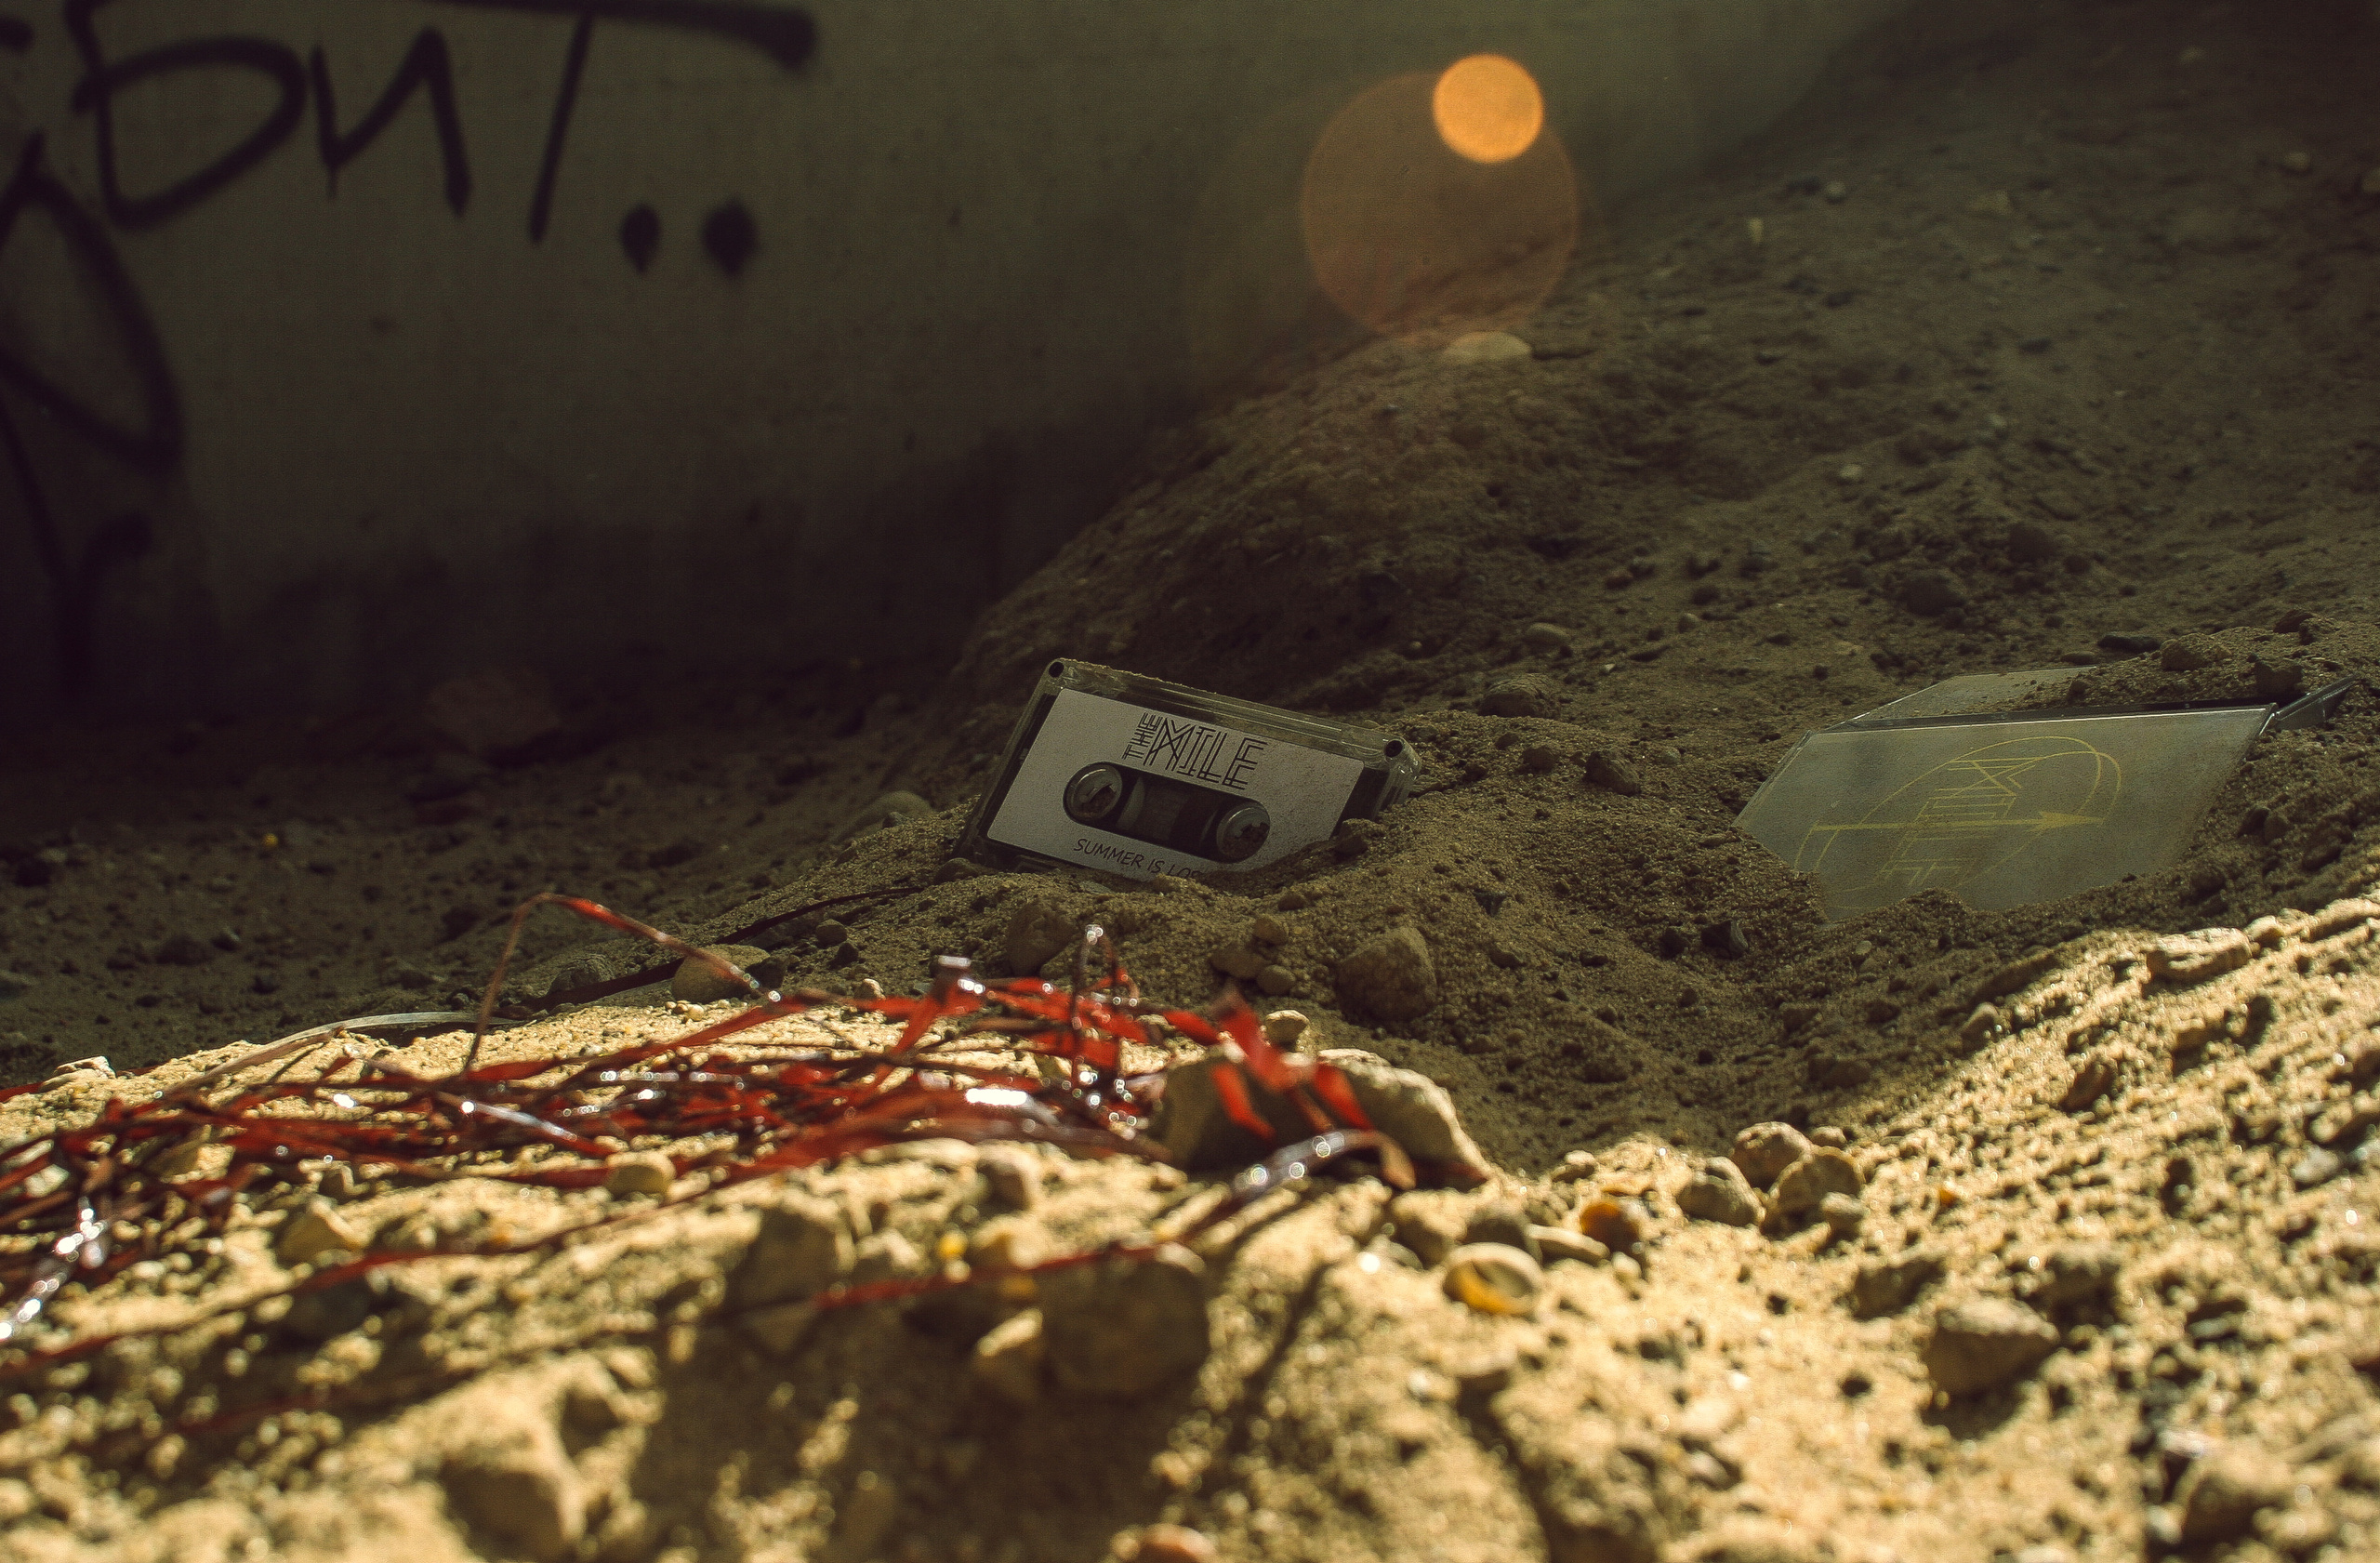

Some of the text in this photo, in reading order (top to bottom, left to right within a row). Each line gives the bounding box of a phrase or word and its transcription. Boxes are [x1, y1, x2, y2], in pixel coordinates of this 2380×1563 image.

[1122, 712, 1268, 790] THE MILE
[1074, 839, 1144, 868] SUMMER
[1147, 859, 1166, 874] IS
